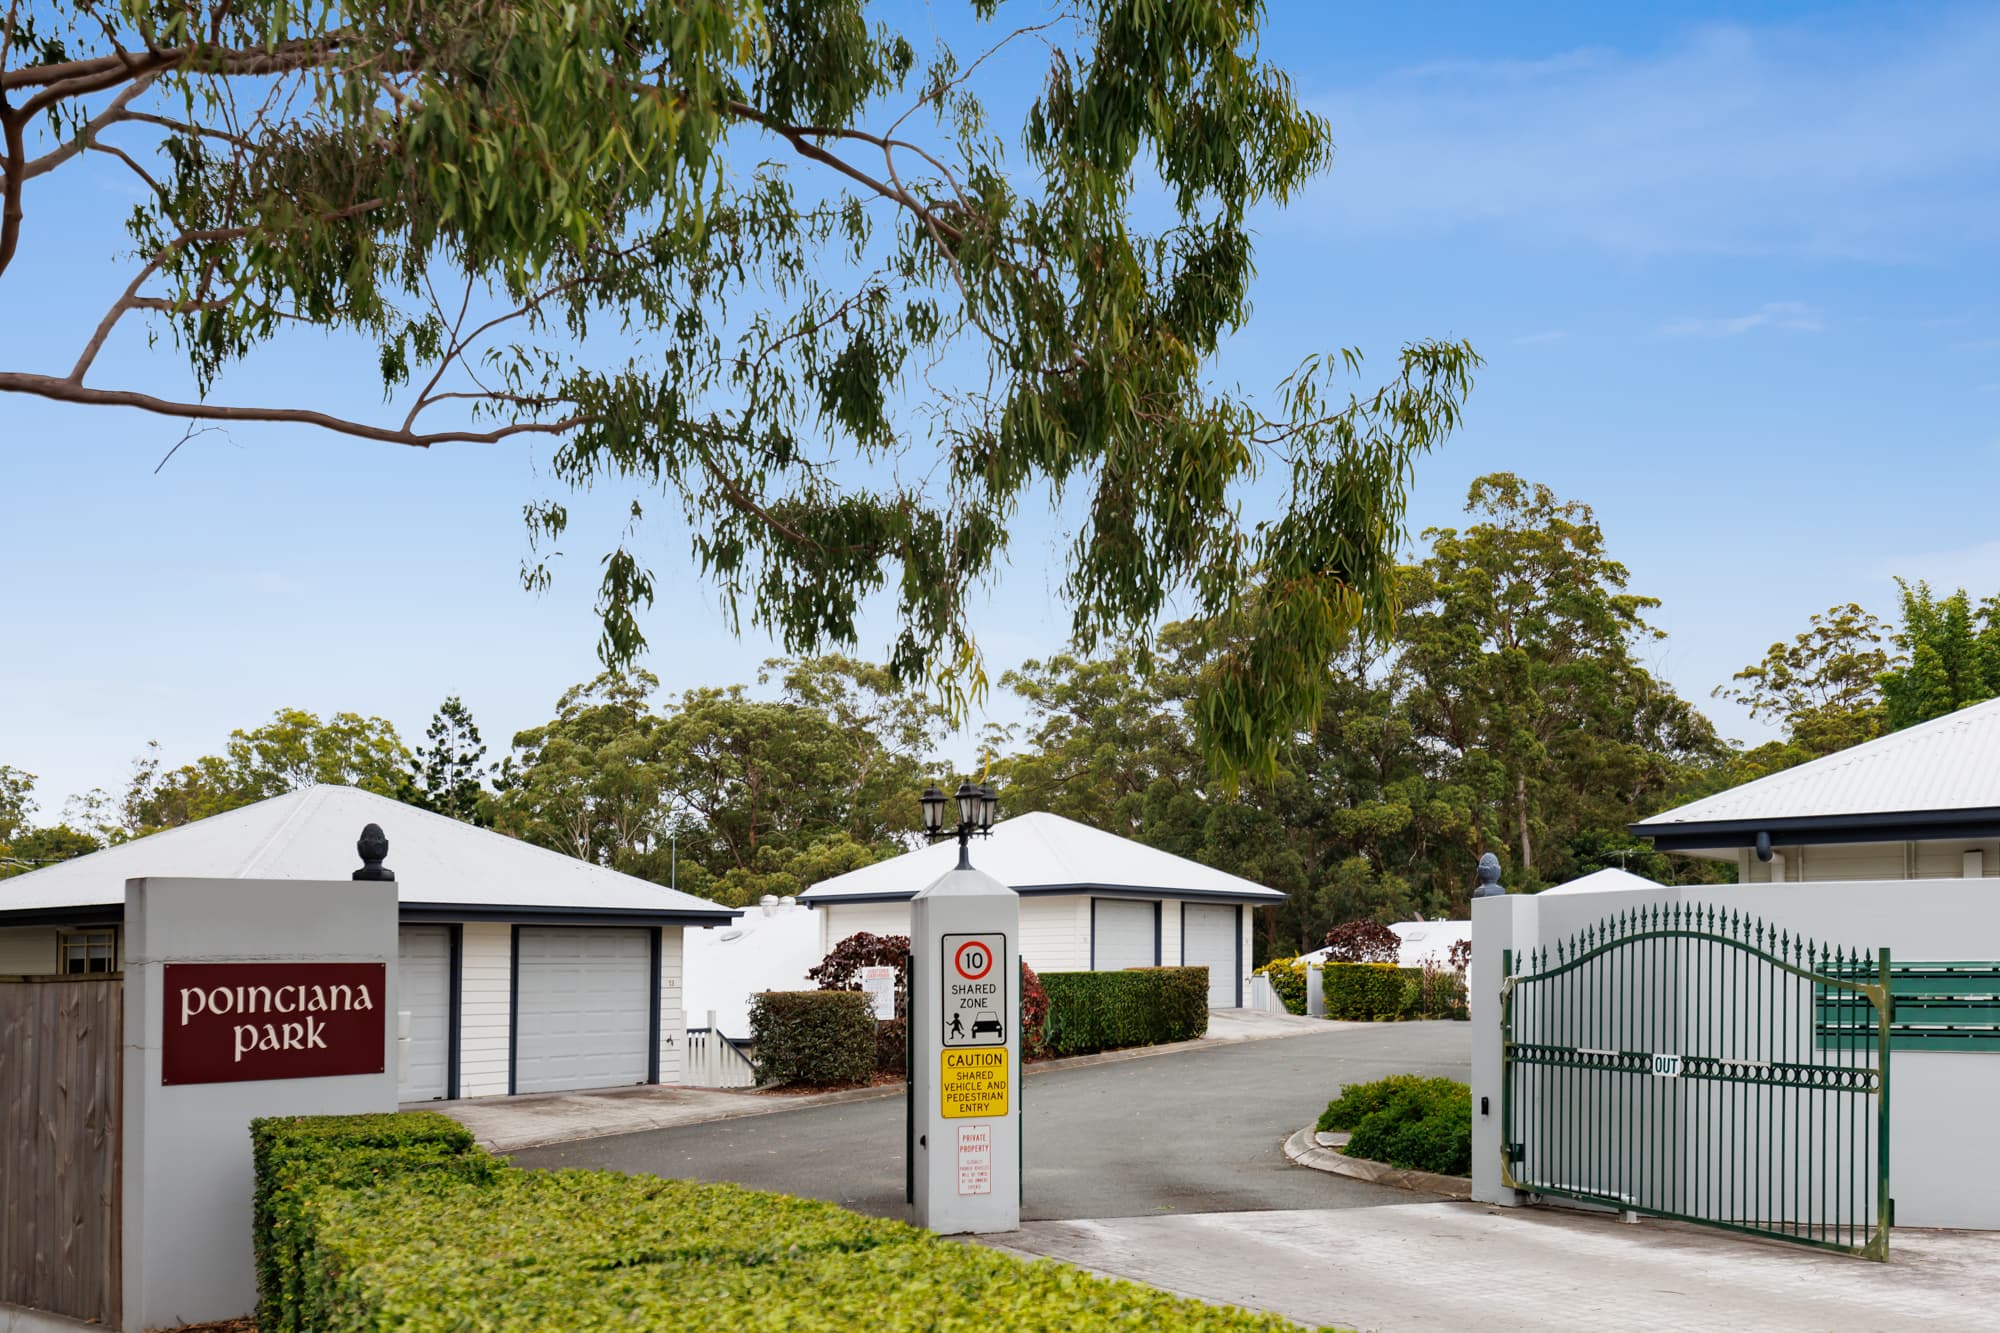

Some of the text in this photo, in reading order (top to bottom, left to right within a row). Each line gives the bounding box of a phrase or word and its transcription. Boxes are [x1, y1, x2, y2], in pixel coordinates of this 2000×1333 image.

[966, 952, 983, 969] 10
[951, 984, 997, 995] SHARED
[179, 984, 373, 1026] poinciana
[960, 998, 988, 1009] ZONE
[233, 1015, 328, 1062] park
[947, 1053, 1002, 1067] CAUTION
[1655, 1056, 1678, 1073] OUT
[956, 1071, 994, 1080] SHARED
[944, 1081, 1006, 1091] VEHICLE AND
[946, 1091, 1003, 1102] PEDESTRIAN
[959, 1102, 990, 1112] ENTRY
[962, 1134, 986, 1142] PRIVATE
